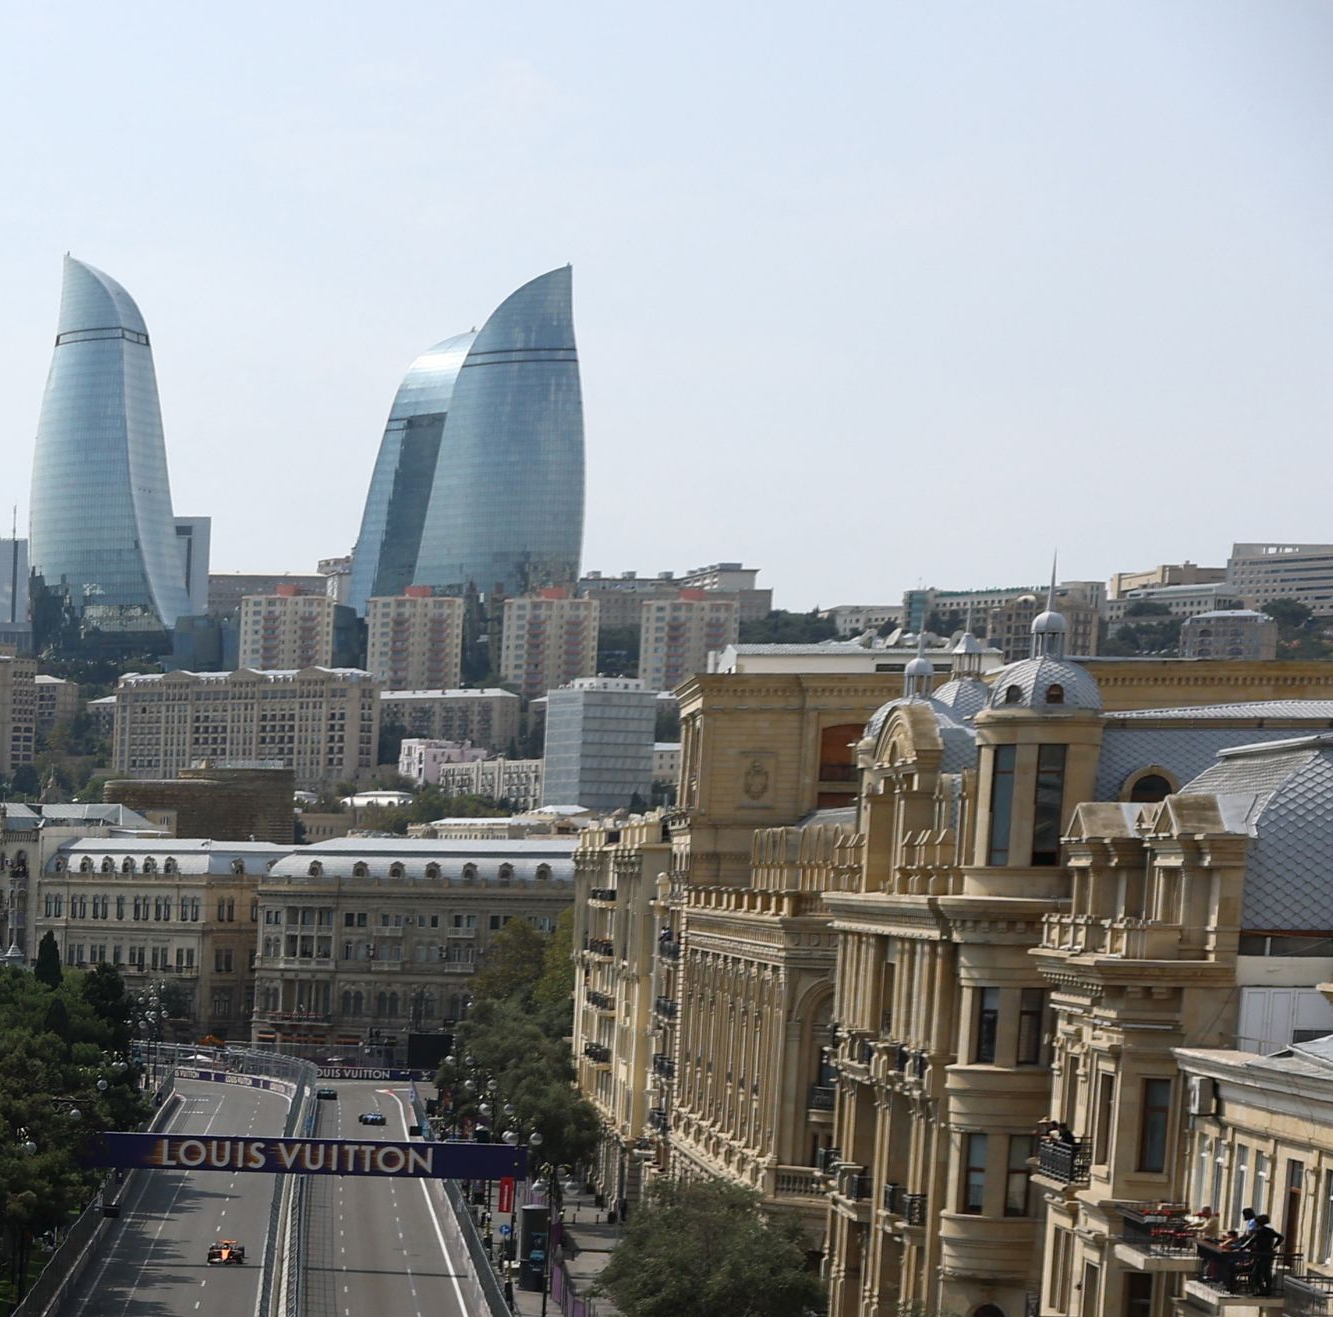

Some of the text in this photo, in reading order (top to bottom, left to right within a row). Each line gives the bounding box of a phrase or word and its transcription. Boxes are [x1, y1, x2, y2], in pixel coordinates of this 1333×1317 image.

[316, 1068, 341, 1078] OUIS
[343, 1069, 391, 1080] VUITTON
[161, 1138, 433, 1175] LOUIS VUITTON
